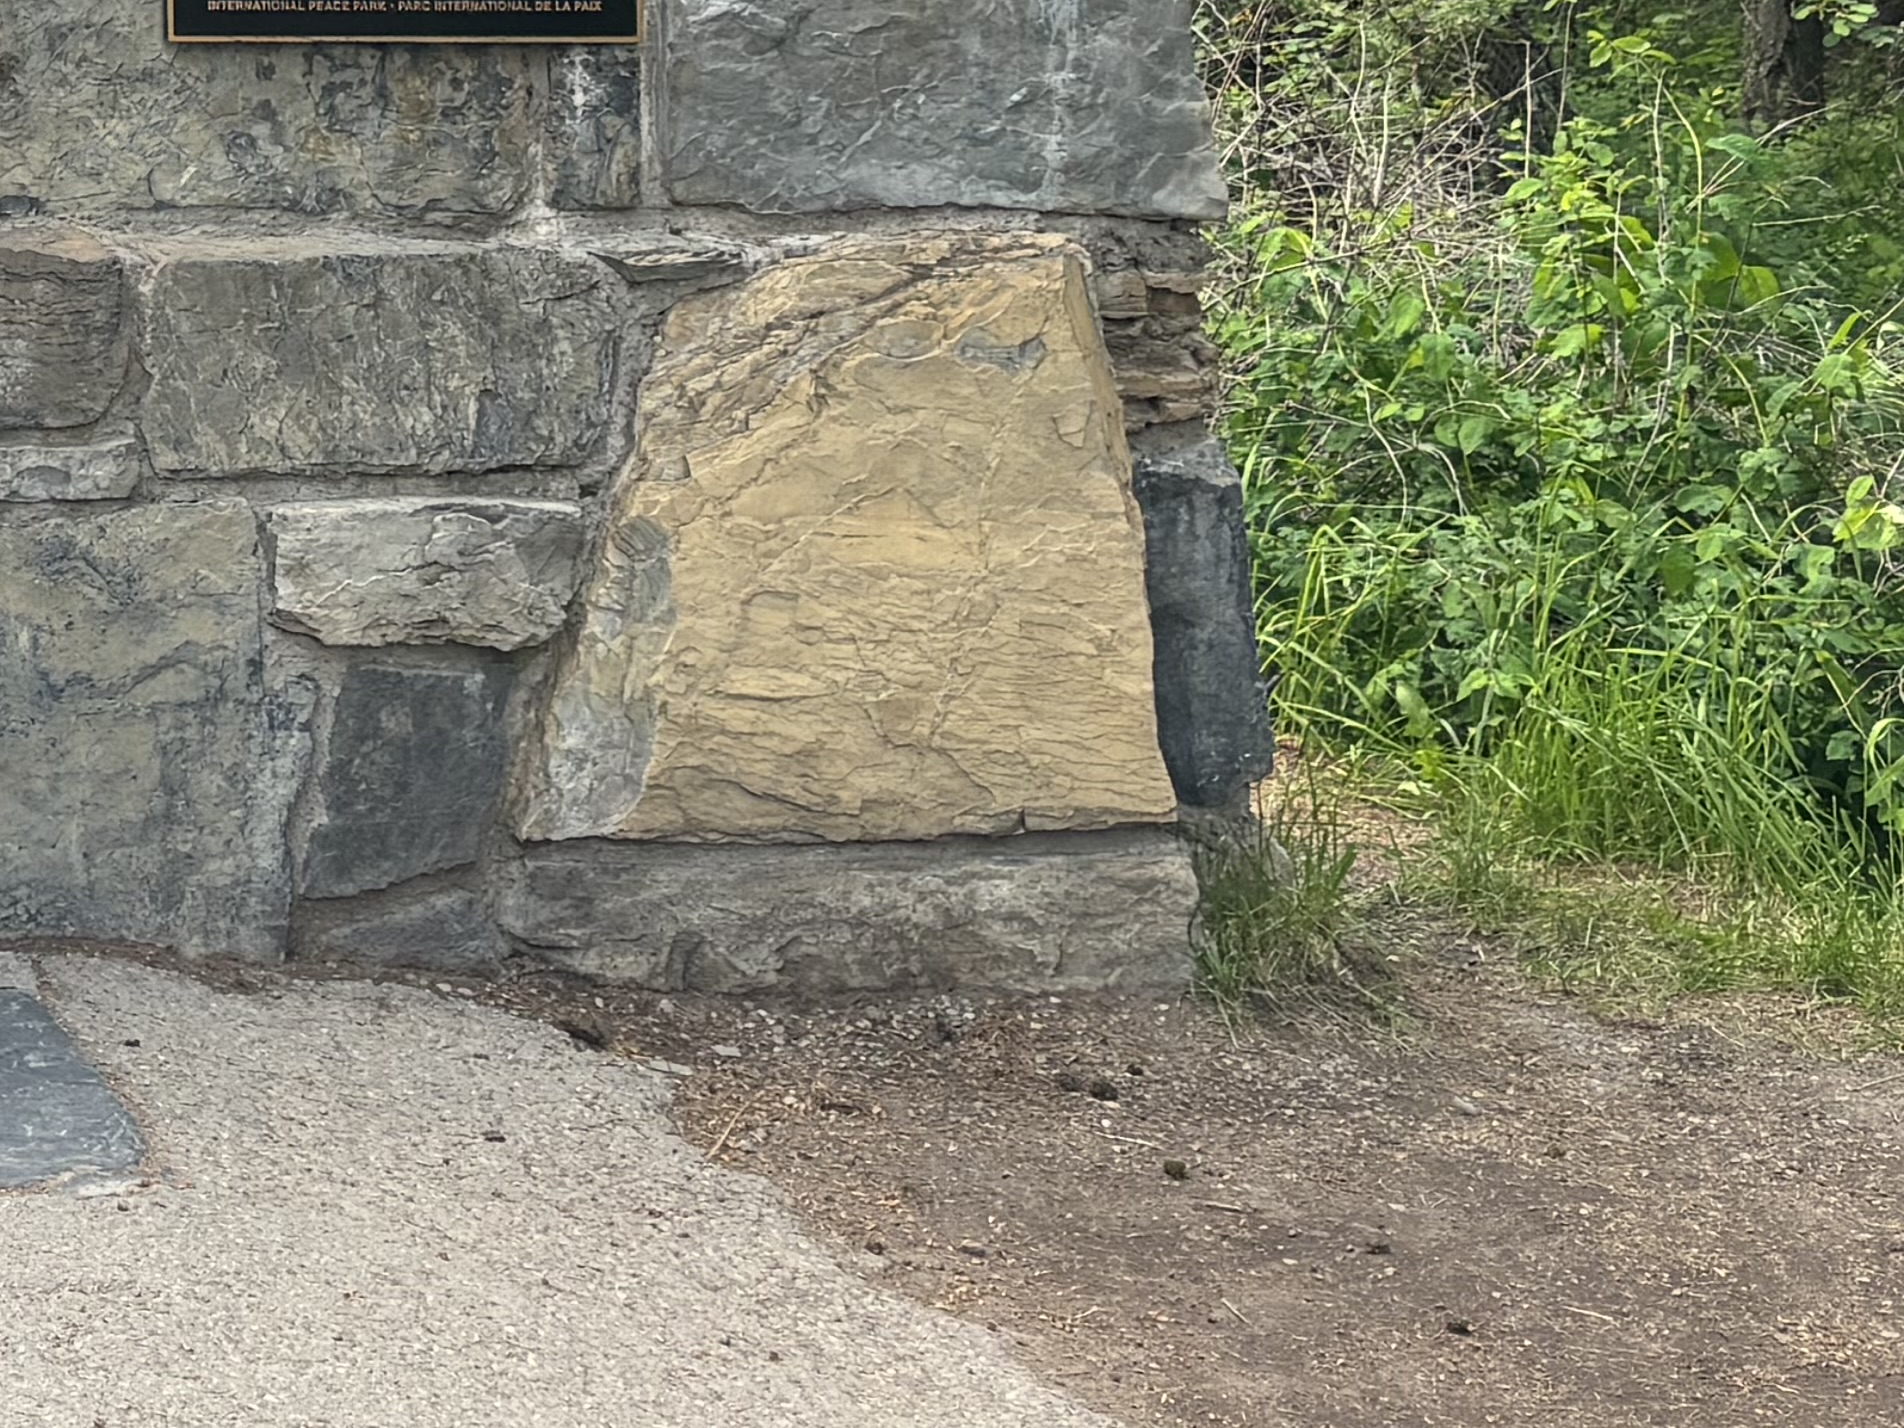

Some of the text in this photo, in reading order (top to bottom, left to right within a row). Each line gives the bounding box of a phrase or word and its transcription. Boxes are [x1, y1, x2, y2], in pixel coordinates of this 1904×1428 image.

[207, 0, 603, 12] INTERNATIONAL PEACE PARK PARC INTERNATIONAL DE LA PAIX
